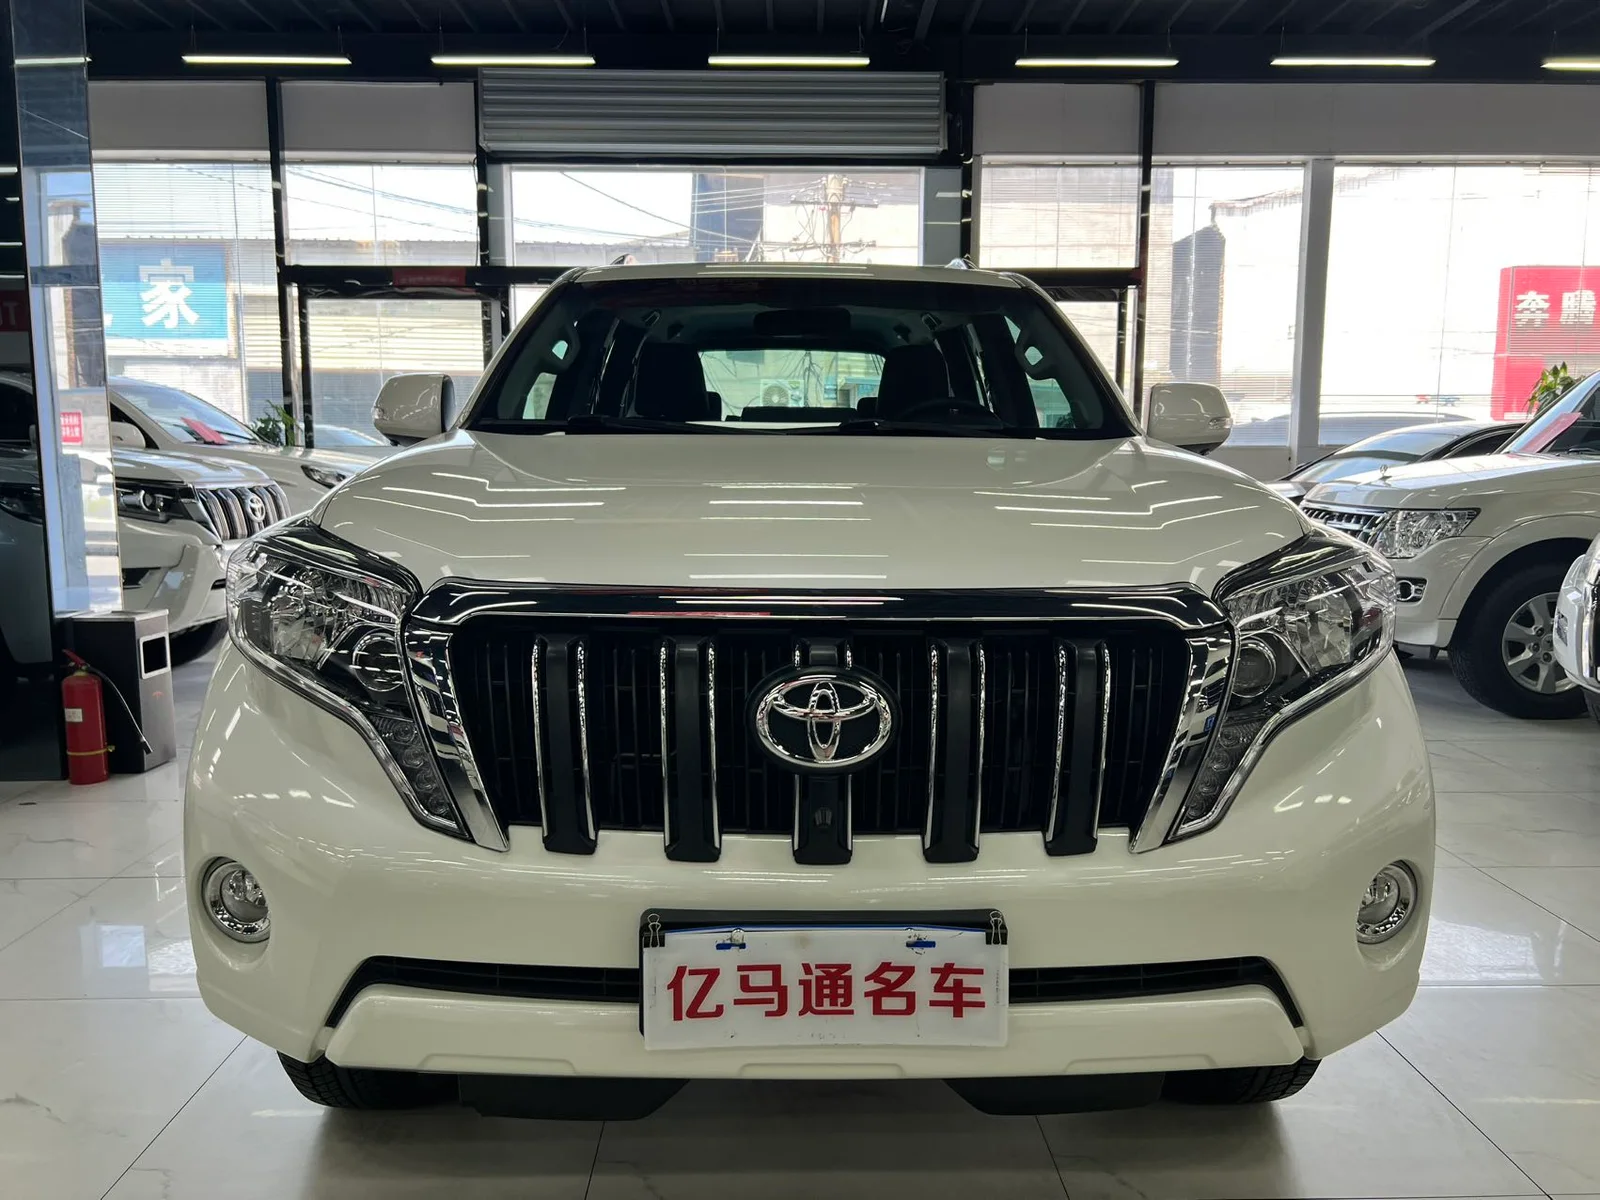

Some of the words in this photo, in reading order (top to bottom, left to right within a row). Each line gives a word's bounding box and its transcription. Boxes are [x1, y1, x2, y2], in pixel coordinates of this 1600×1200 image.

[102, 259, 200, 328] 家
[666, 961, 986, 1022] 亿马通名车
